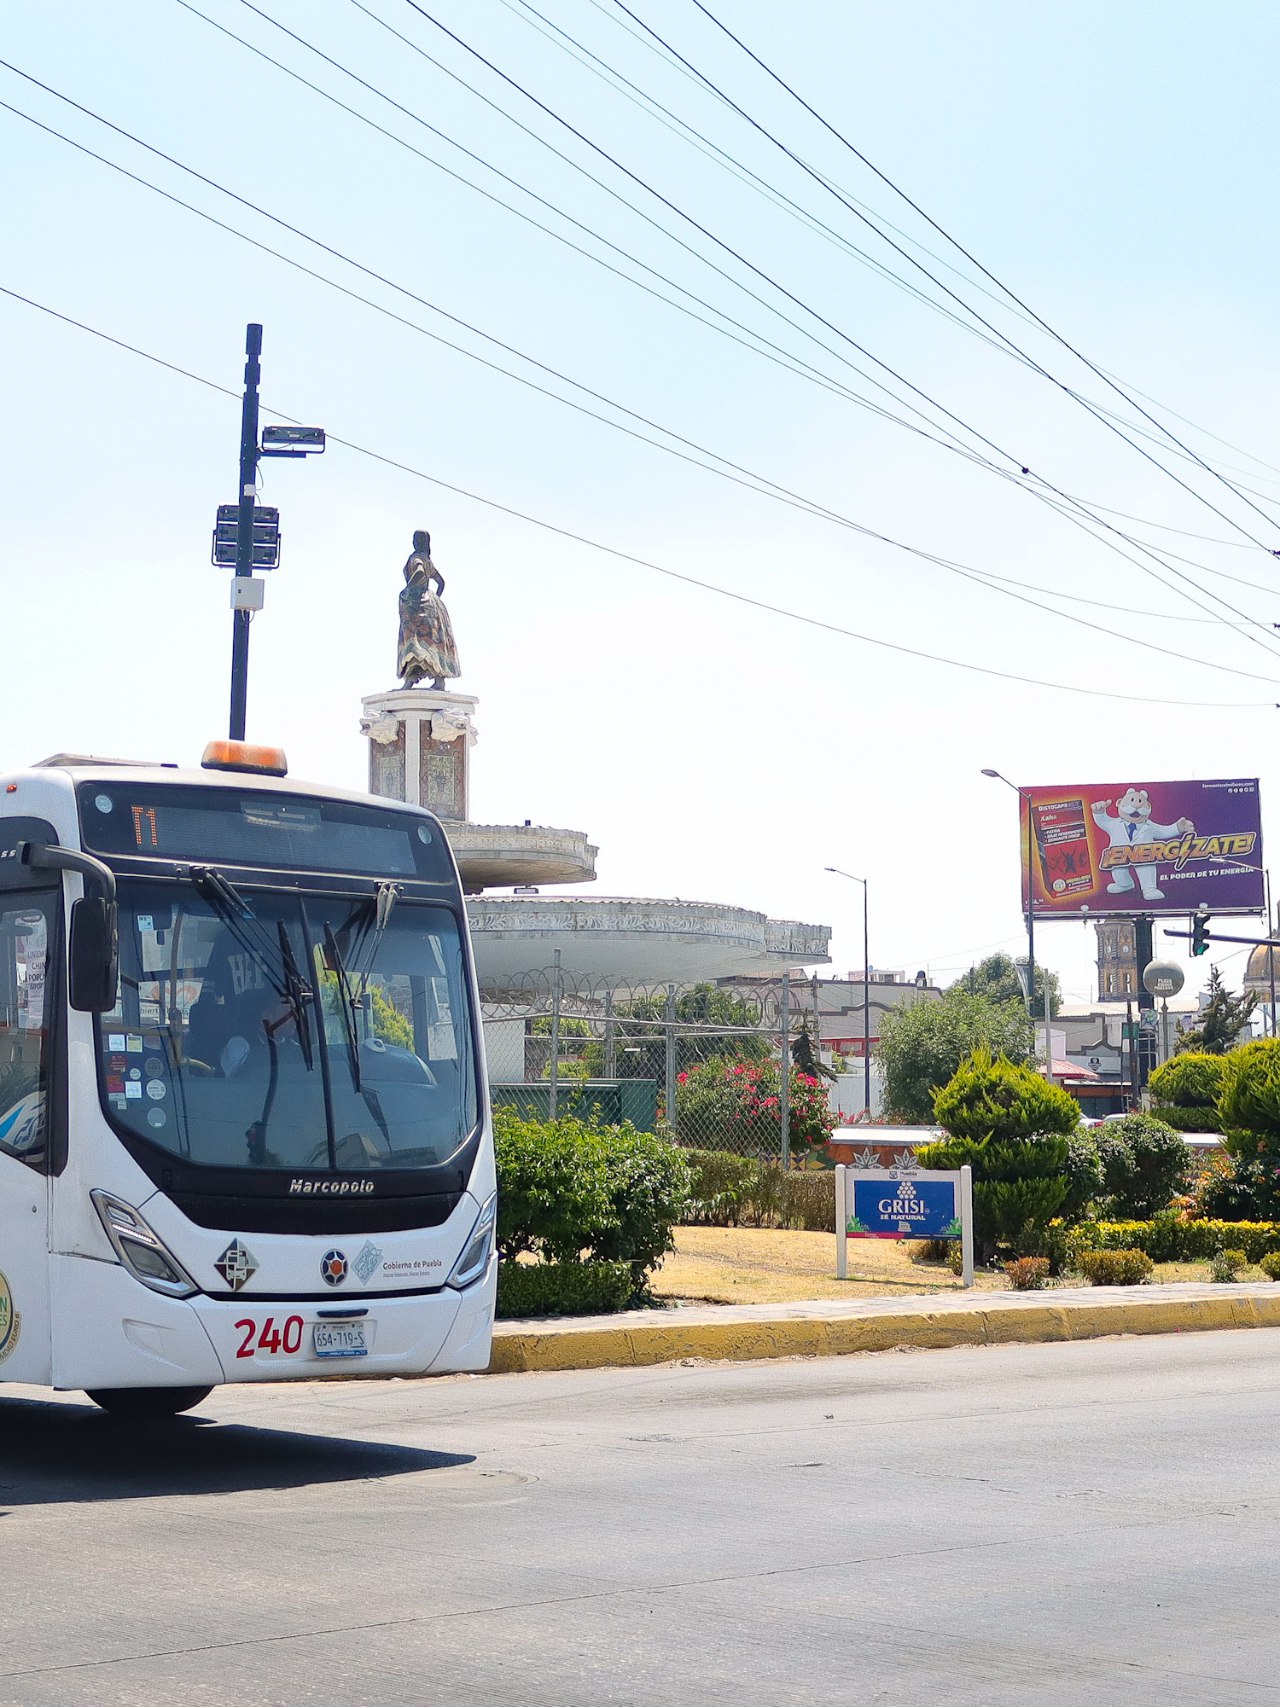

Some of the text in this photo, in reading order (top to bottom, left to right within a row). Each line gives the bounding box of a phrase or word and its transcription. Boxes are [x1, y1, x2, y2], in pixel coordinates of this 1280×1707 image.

[131, 806, 158, 845] T1
[1170, 872, 1196, 880] PODER
[1197, 870, 1207, 878] DE
[1208, 869, 1220, 877] TU
[289, 1179, 375, 1195] Marcopolo
[878, 1199, 924, 1214] GRISI
[382, 1258, 442, 1270] Gobierno de Puebla
[234, 1315, 305, 1359] 240
